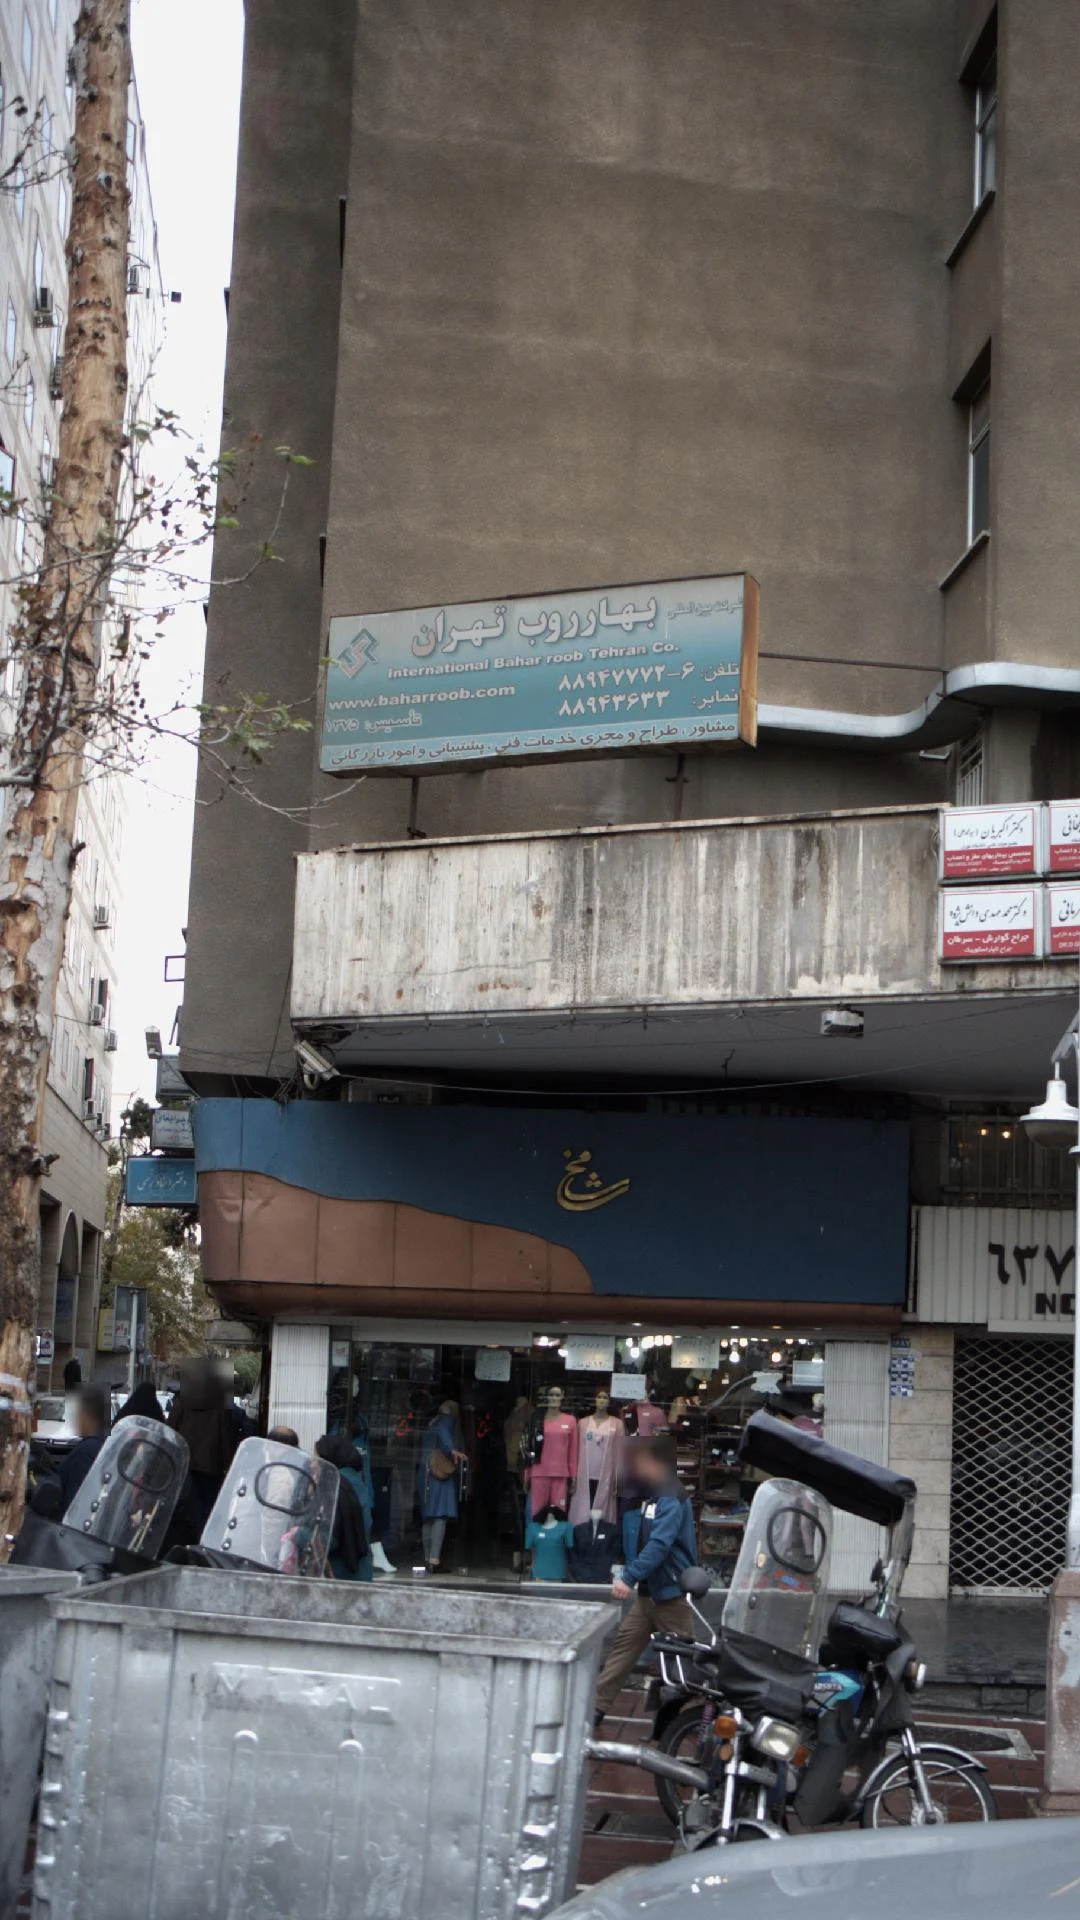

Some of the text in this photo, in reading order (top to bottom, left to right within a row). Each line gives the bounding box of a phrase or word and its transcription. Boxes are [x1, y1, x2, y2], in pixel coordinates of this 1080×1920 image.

[411, 605, 507, 658] تهران
[387, 641, 679, 679] International Bahar roob Tehran Co.
[328, 685, 516, 711] www.baharroob.com
[627, 731, 635, 744] و
[639, 725, 678, 743] طراح
[688, 720, 736, 738] مشاور
[495, 736, 520, 753] فنی
[523, 732, 577, 748] خدمات
[580, 731, 624, 747] مجری
[389, 745, 416, 761] امور
[418, 747, 426, 757] و
[429, 741, 485, 758] پشتیبانی
[1008, 814, 1028, 837] دکتر
[1008, 896, 1028, 924] دکتر
[947, 935, 973, 945] سرطان
[982, 932, 1010, 944] گوارش
[1010, 933, 1029, 944] جراح
